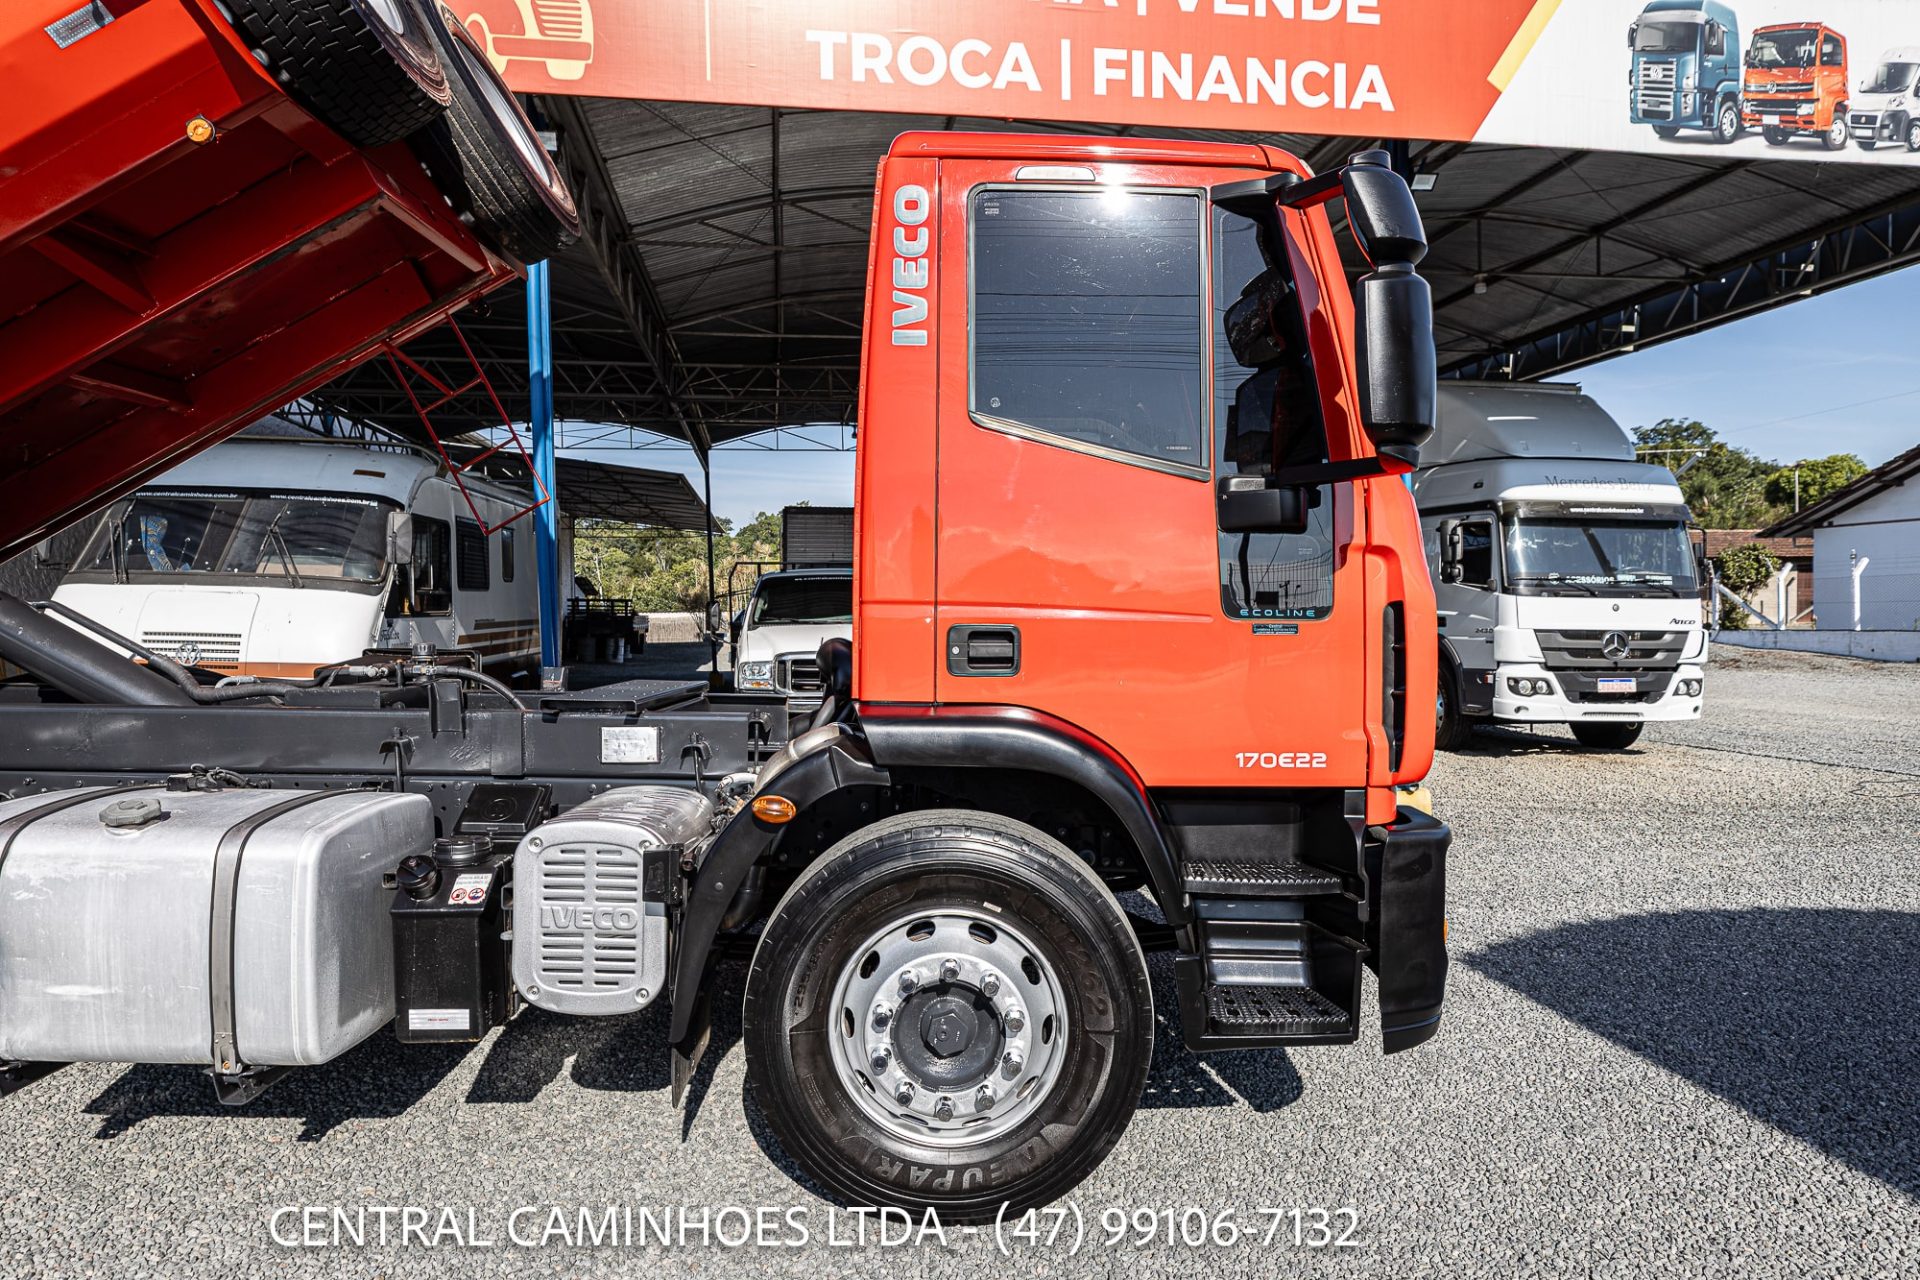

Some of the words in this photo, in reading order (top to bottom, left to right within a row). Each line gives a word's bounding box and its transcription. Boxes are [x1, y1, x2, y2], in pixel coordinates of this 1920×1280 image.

[805, 29, 1042, 92] TROCA
[1093, 47, 1395, 112] FINANCIA
[892, 184, 930, 346] IVECO
[1240, 609, 1316, 617] ECOLINE
[1235, 752, 1328, 769] 170E22
[540, 906, 638, 931] IVECO
